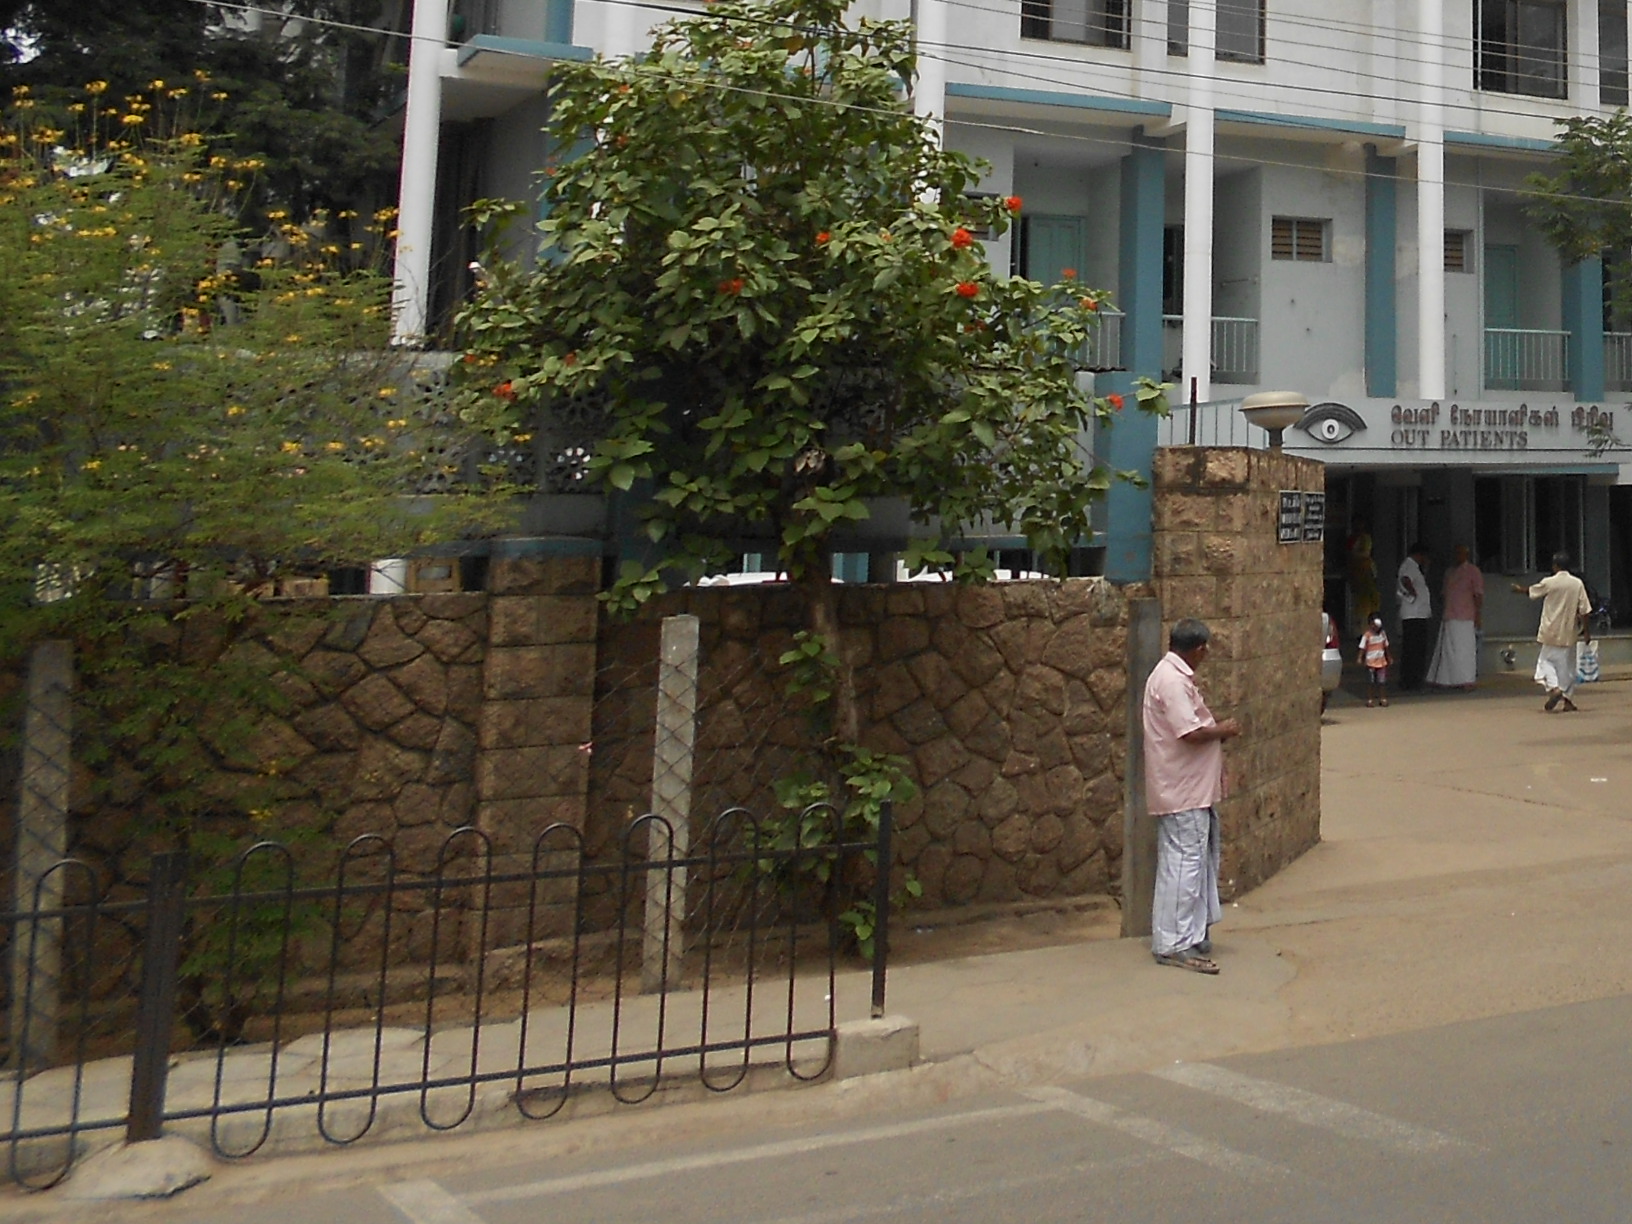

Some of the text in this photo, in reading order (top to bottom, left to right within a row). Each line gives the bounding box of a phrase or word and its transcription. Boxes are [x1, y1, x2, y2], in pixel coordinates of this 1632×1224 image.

[1391, 401, 1440, 425] வெளி
[1391, 429, 1528, 447] OUT PATIENTS
